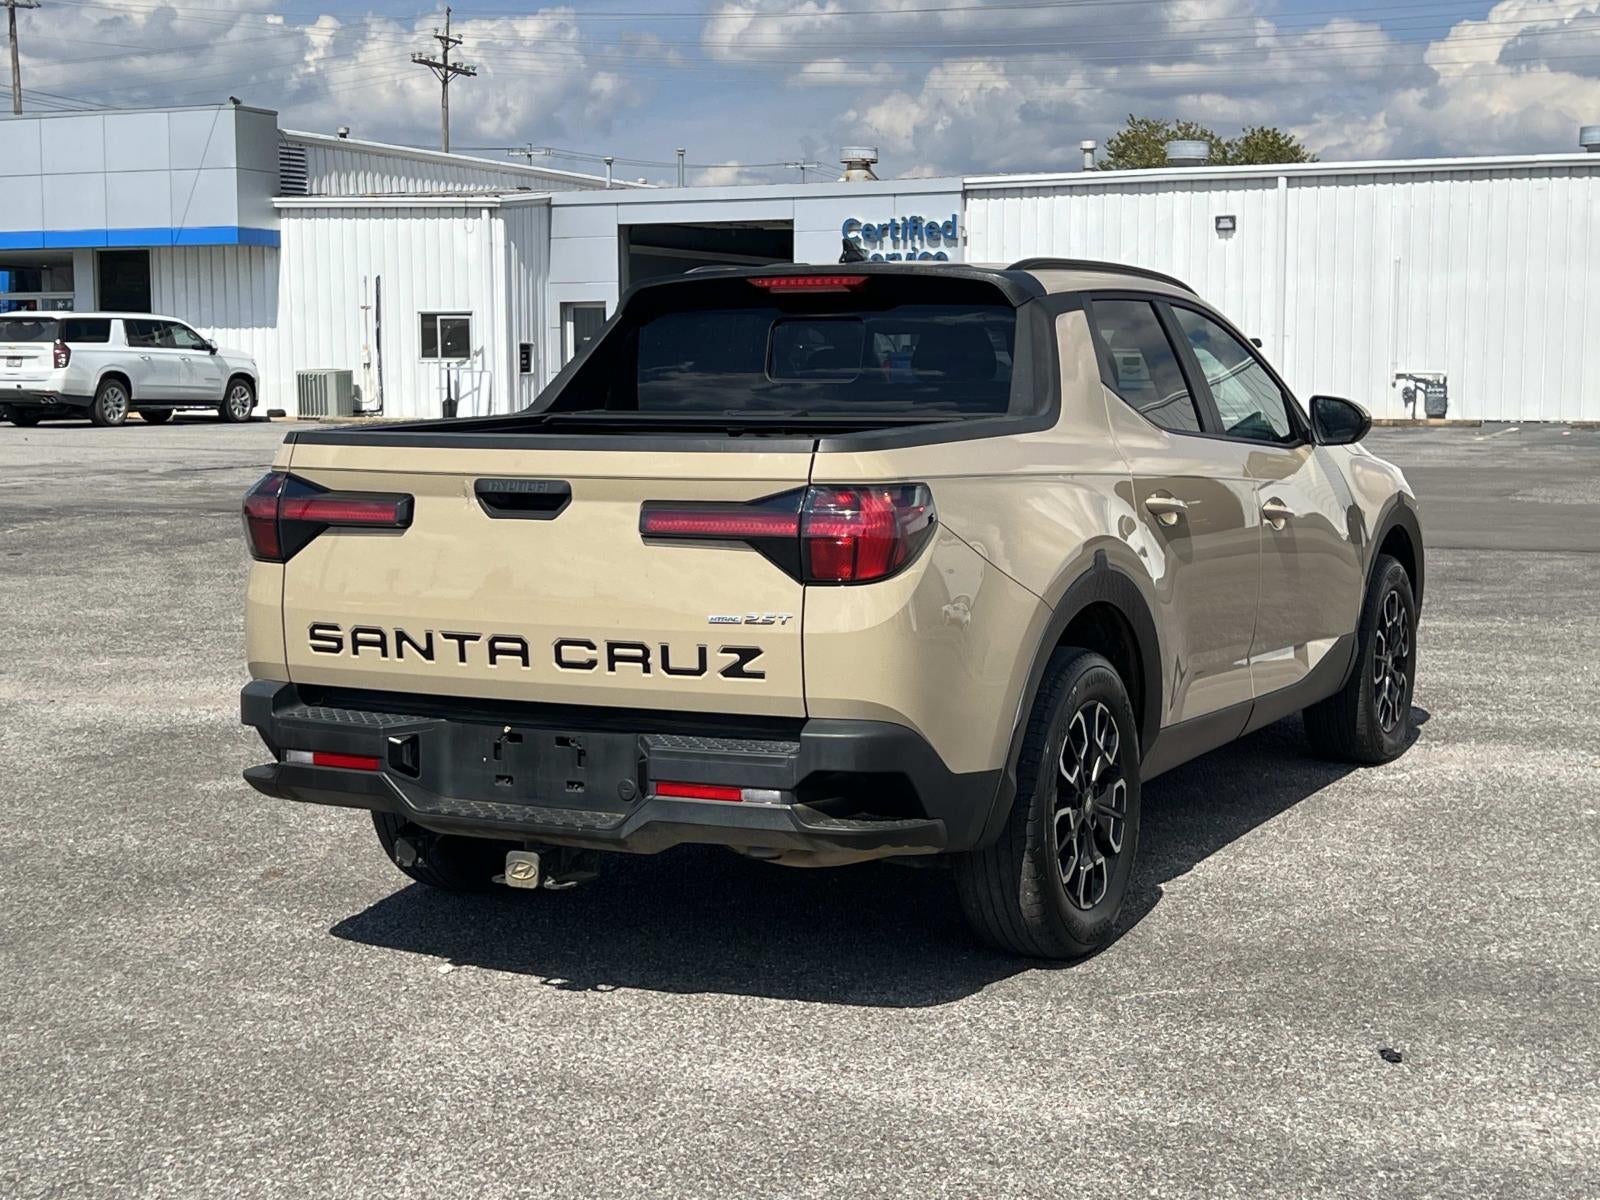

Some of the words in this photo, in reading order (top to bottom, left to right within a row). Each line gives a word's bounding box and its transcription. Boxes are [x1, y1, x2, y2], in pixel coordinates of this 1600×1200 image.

[842, 213, 958, 241] Certified
[308, 621, 531, 670] SANTA
[552, 637, 767, 681] CRUZ
